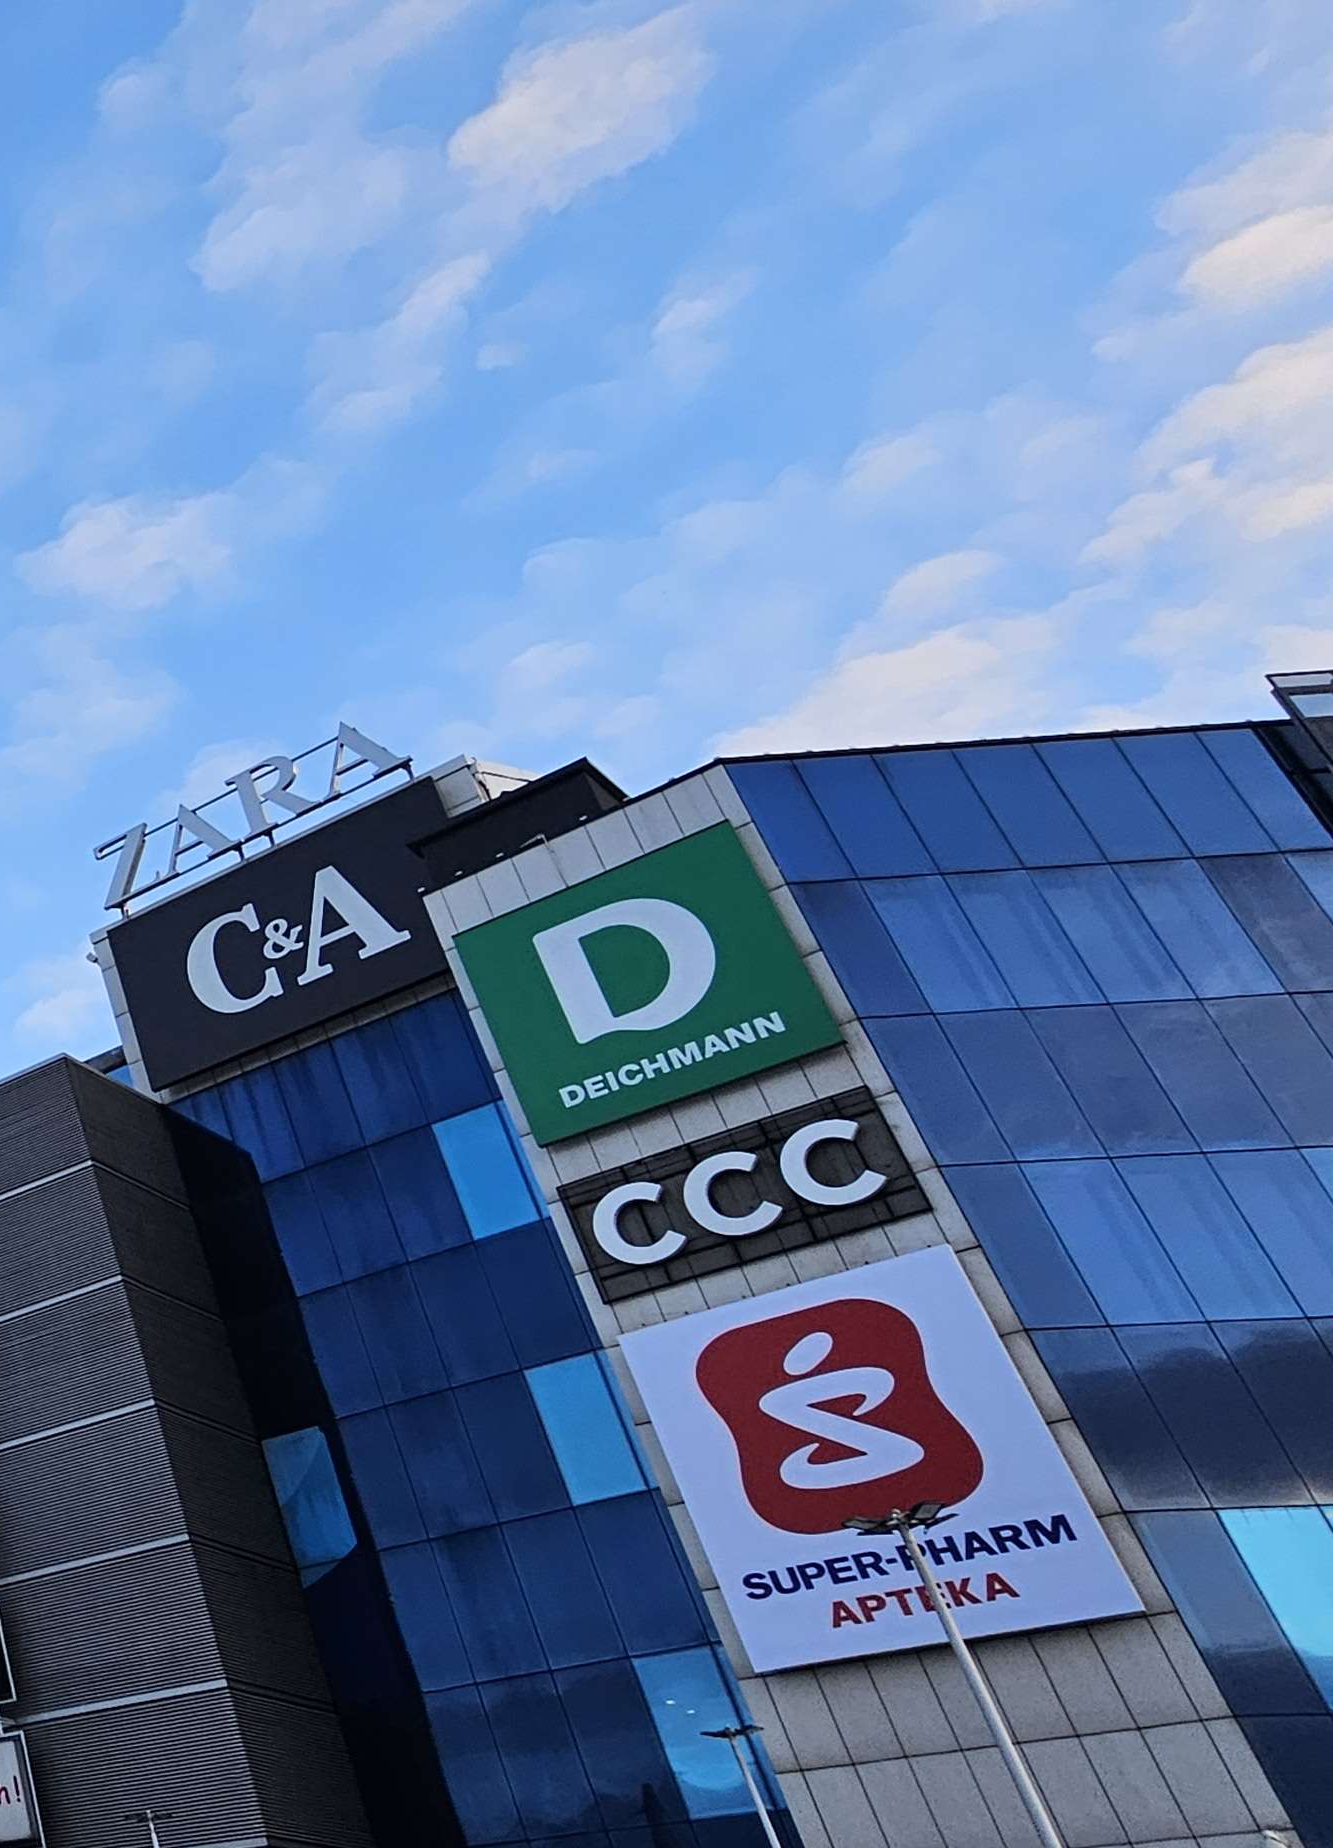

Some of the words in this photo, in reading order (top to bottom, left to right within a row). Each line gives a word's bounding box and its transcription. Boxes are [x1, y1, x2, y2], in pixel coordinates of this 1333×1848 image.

[94, 721, 413, 911] ZARA
[186, 865, 411, 1014] C&A
[532, 898, 717, 1046] D
[558, 1011, 785, 1110] DEICHMANN
[592, 1119, 889, 1266] CCC
[742, 1514, 1078, 1601] SUPER-PHARM
